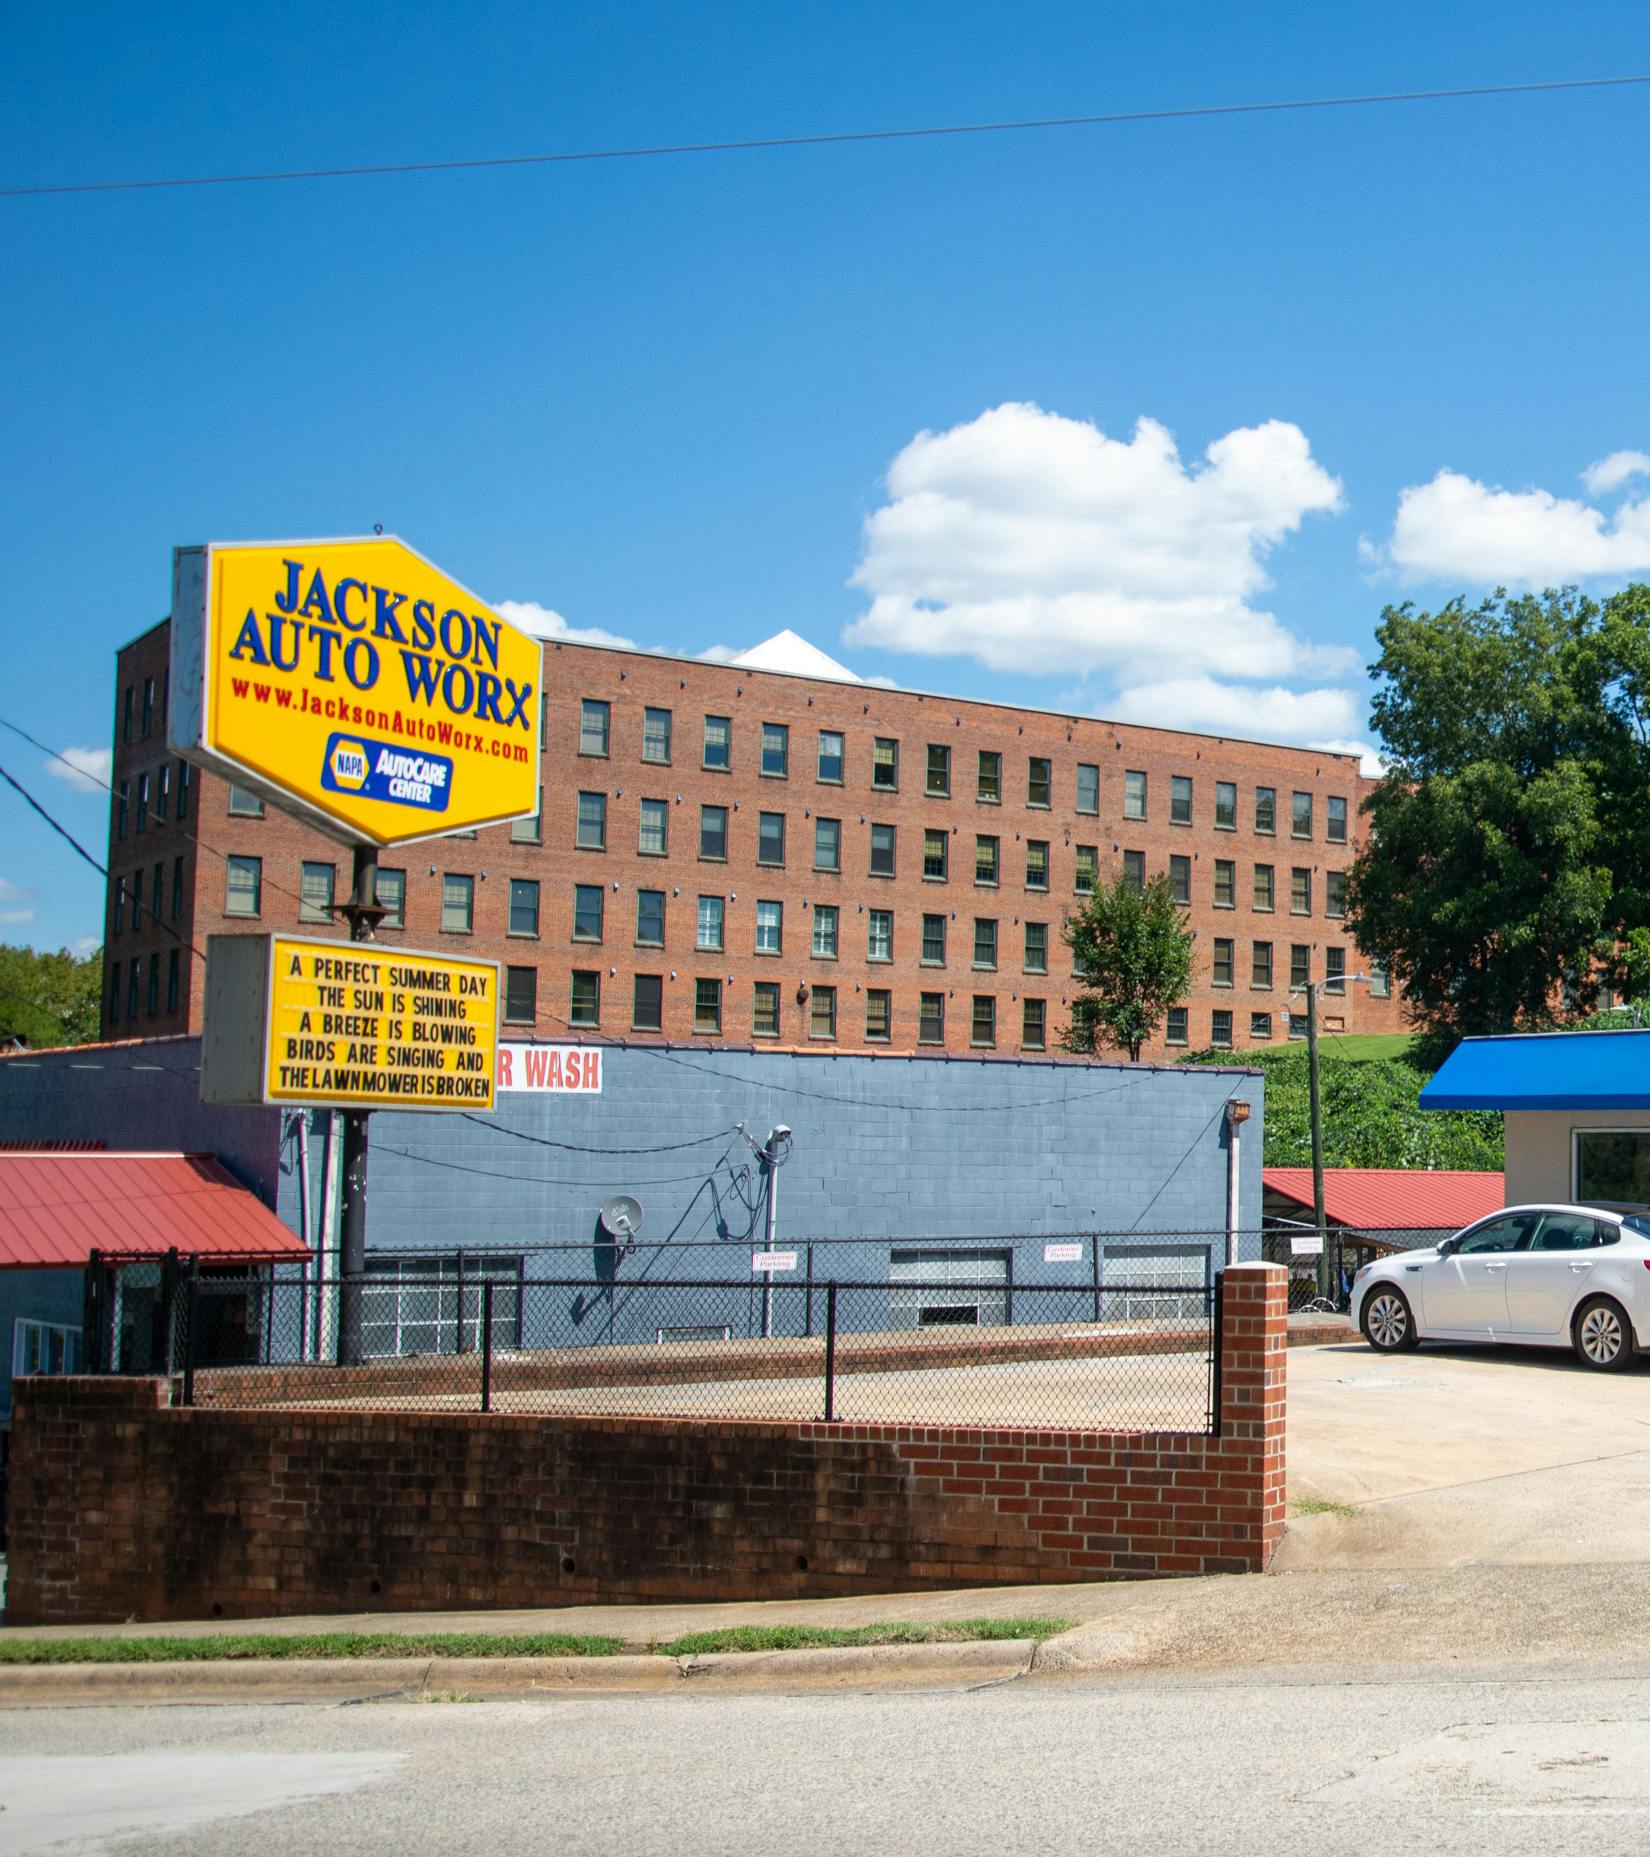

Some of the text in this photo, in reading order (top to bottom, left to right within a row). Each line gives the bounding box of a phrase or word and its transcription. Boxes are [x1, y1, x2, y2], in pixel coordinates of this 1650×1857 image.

[275, 559, 502, 671] JACKSON
[229, 608, 532, 731] AUTO WORX
[231, 677, 529, 764] www.JacksonAutoWorx.com
[337, 751, 363, 777] NAPA
[389, 778, 432, 803] CENTER
[290, 955, 488, 997] A PERFECT SUMMER DAY
[317, 986, 466, 1019] THE SUN IS SHINING
[300, 1011, 476, 1045] A BREEZE IS BLOWING
[287, 1039, 483, 1072] BIRDS ARE SINGING AND
[525, 1050, 599, 1089] WASH
[279, 1066, 309, 1089] THE
[421, 1075, 435, 1095] IS
[436, 1076, 490, 1098] BROKEN
